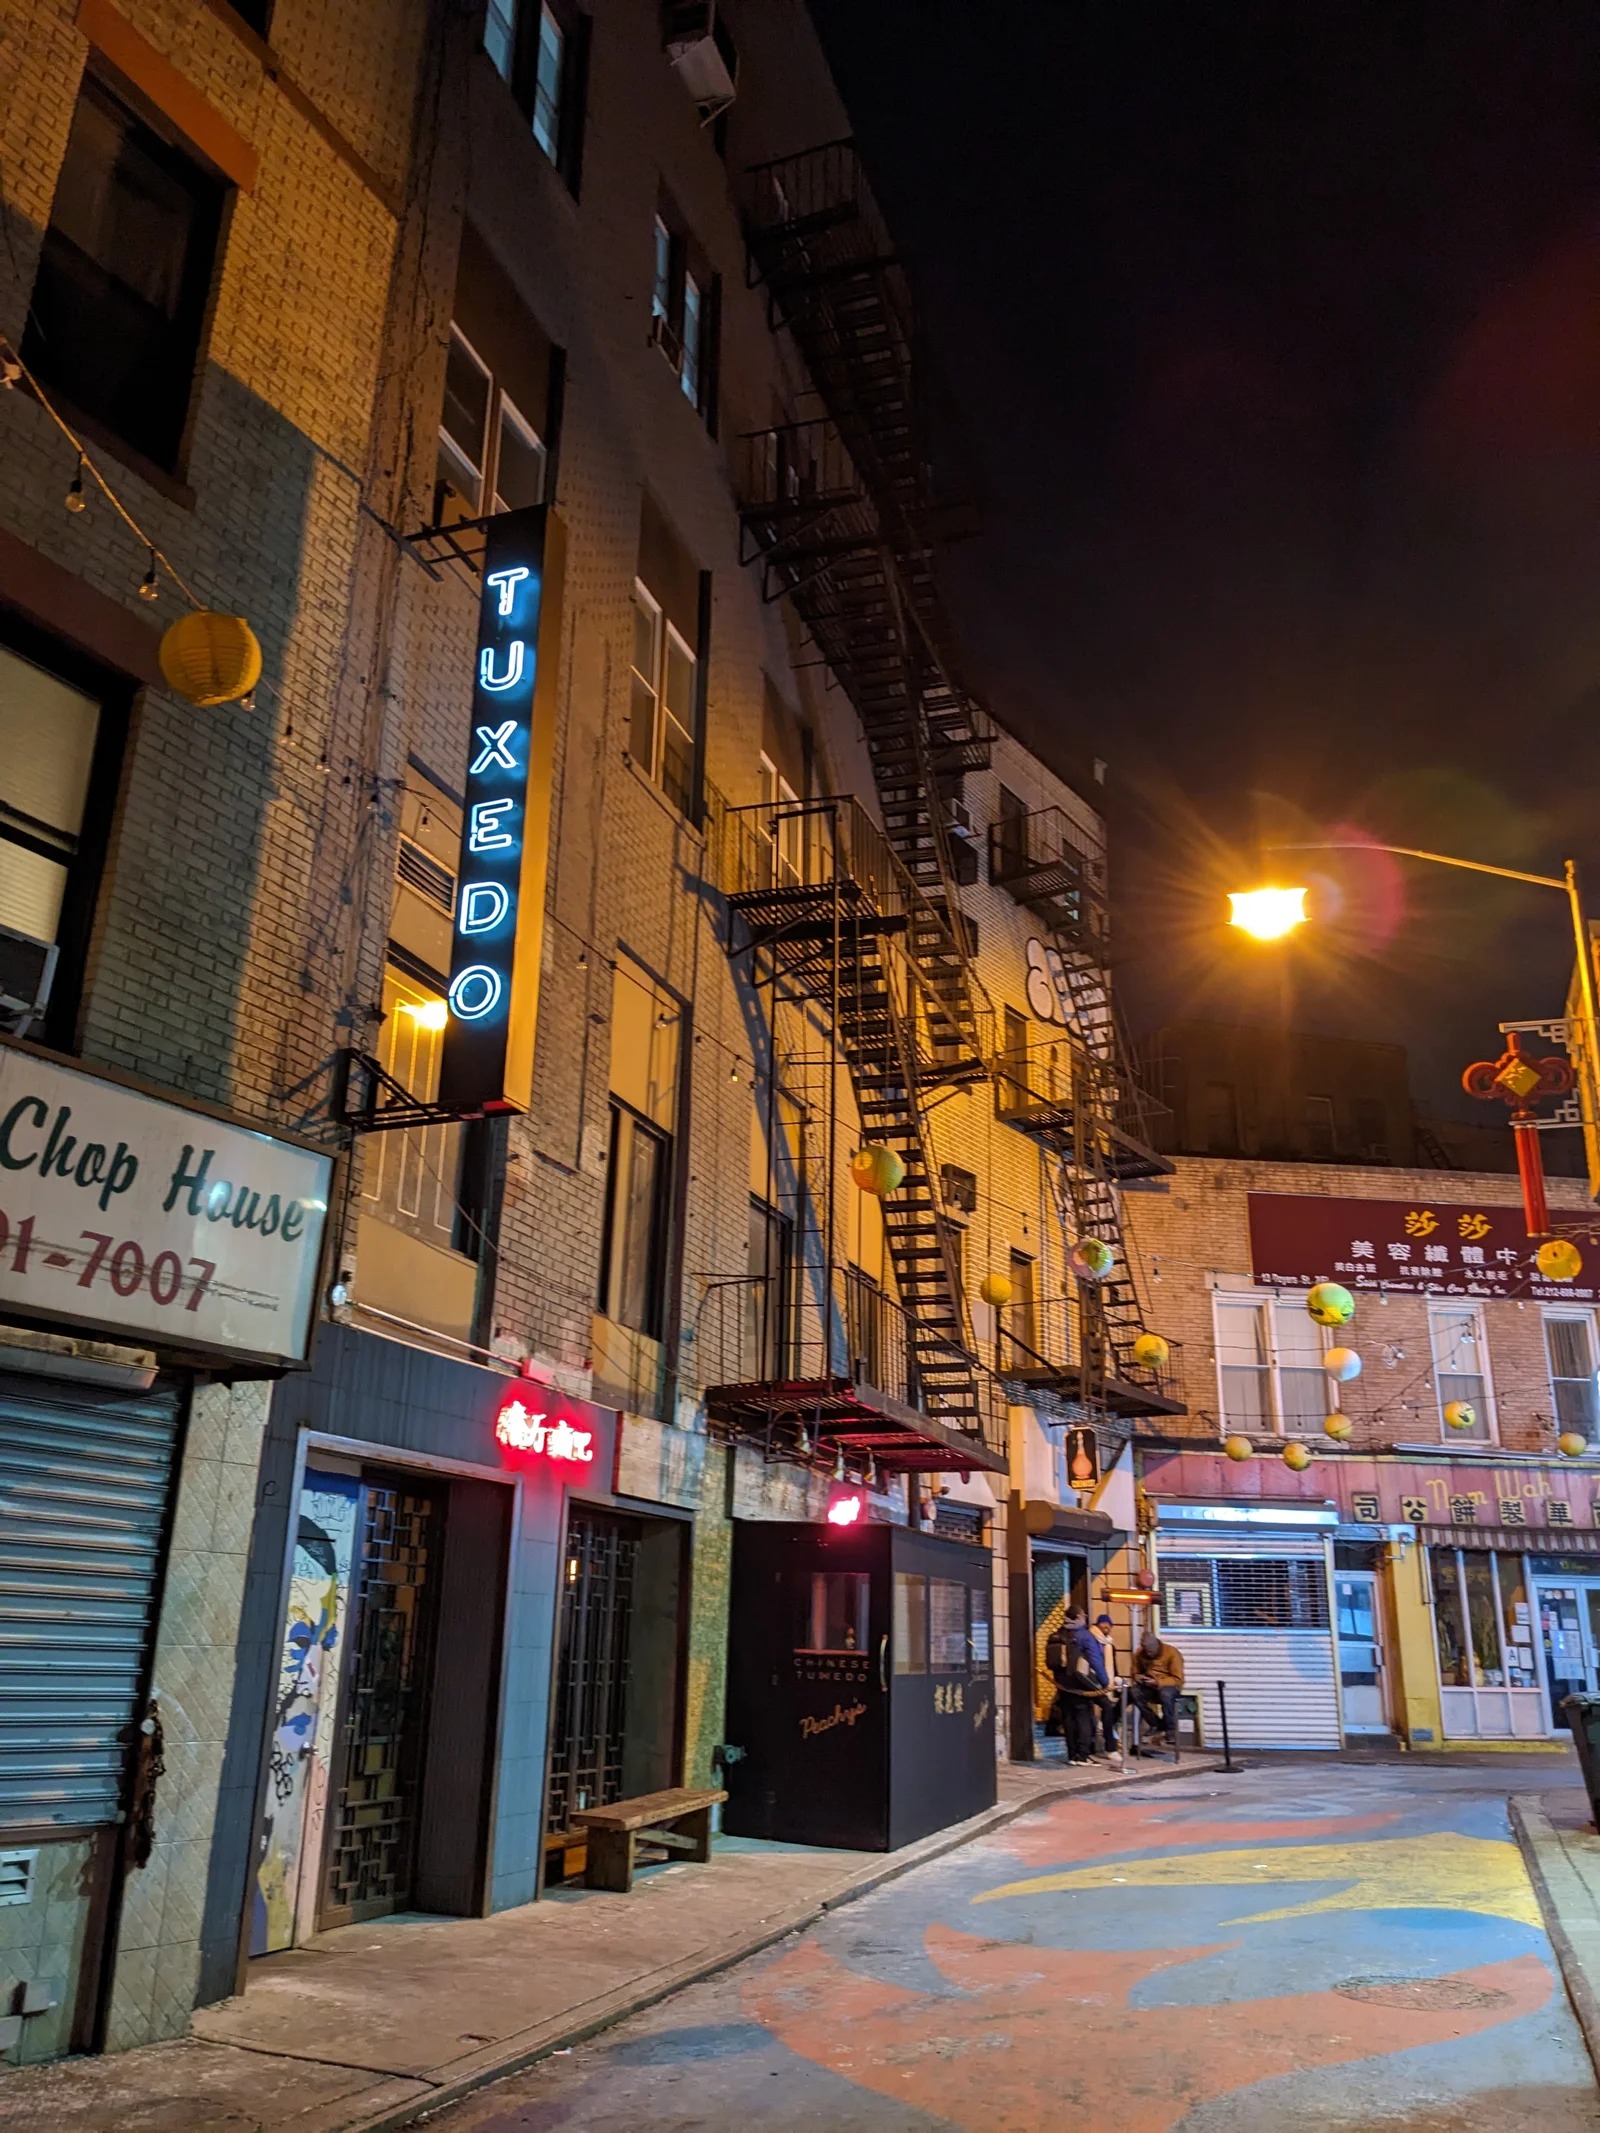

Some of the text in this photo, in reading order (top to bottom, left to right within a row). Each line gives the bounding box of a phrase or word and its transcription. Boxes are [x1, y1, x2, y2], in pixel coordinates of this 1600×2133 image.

[448, 566, 530, 1021] TUXEDO
[0, 1095, 304, 1242] Chop House
[1403, 1210, 1493, 1240] 莎莎
[1494, 1469, 1554, 1499] Wah
[793, 1657, 871, 1670] CHINESE
